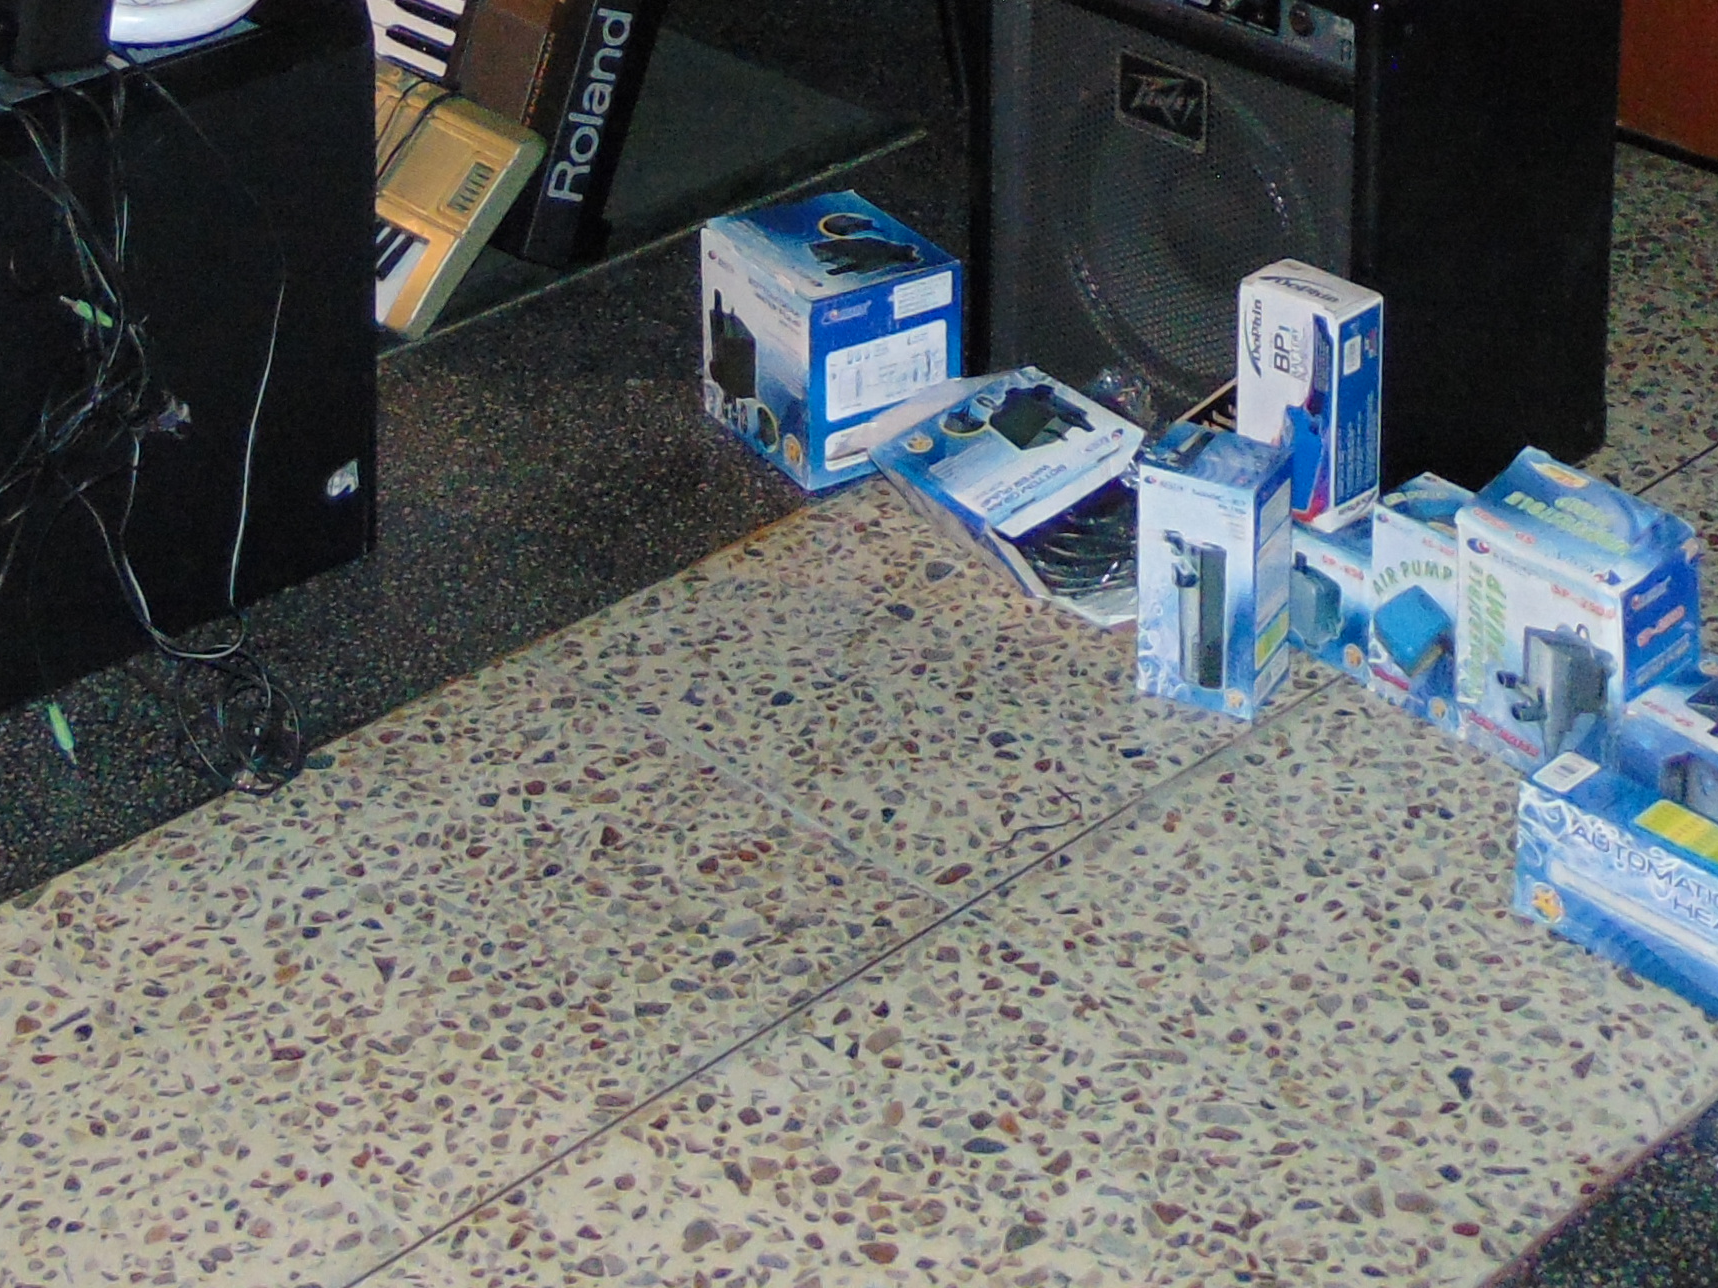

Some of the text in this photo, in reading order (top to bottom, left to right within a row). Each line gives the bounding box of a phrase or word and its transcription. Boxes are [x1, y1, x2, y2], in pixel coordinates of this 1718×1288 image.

[546, 6, 633, 202] Roland
[1372, 559, 1453, 596] AIR PUMP
